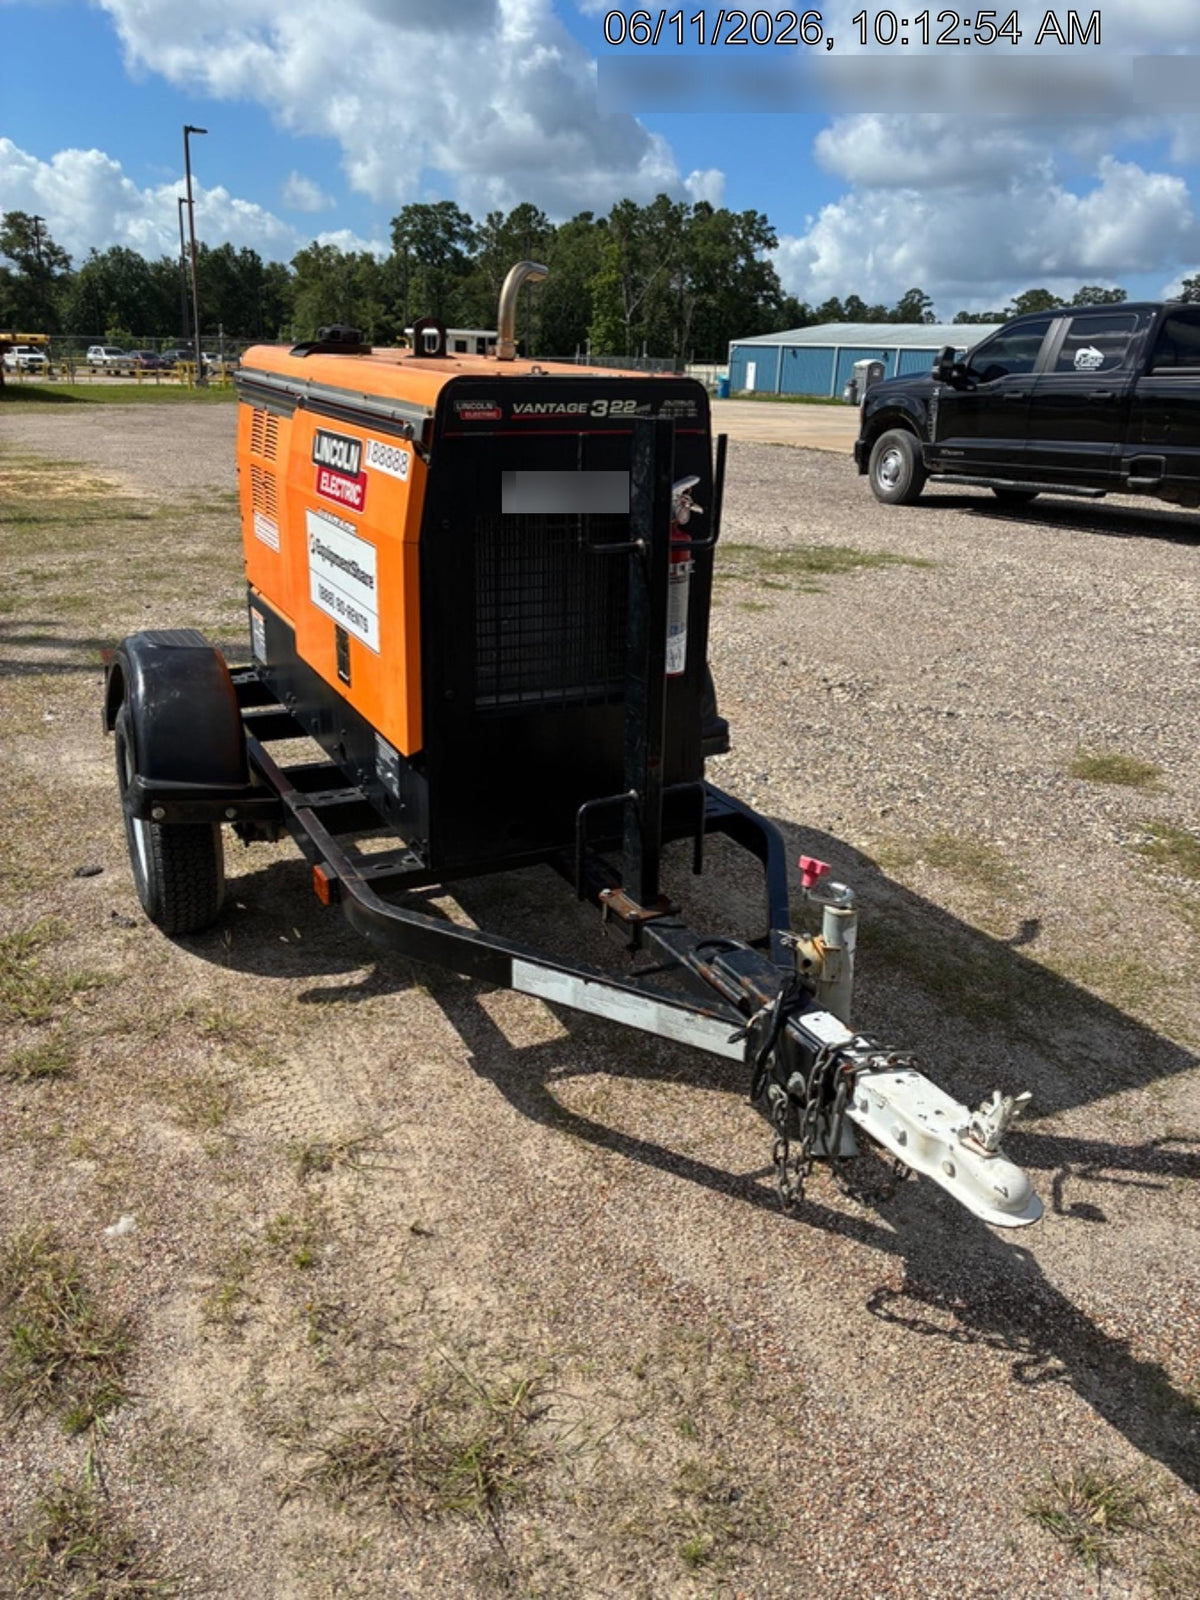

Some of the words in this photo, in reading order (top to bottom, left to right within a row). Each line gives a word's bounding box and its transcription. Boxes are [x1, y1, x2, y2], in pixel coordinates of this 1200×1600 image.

[455, 402, 494, 410] LINCOLN
[512, 402, 589, 414] VANTAGE
[590, 399, 637, 417] 322
[314, 434, 360, 474] LINCOLN
[321, 471, 362, 505] ELECTRIC
